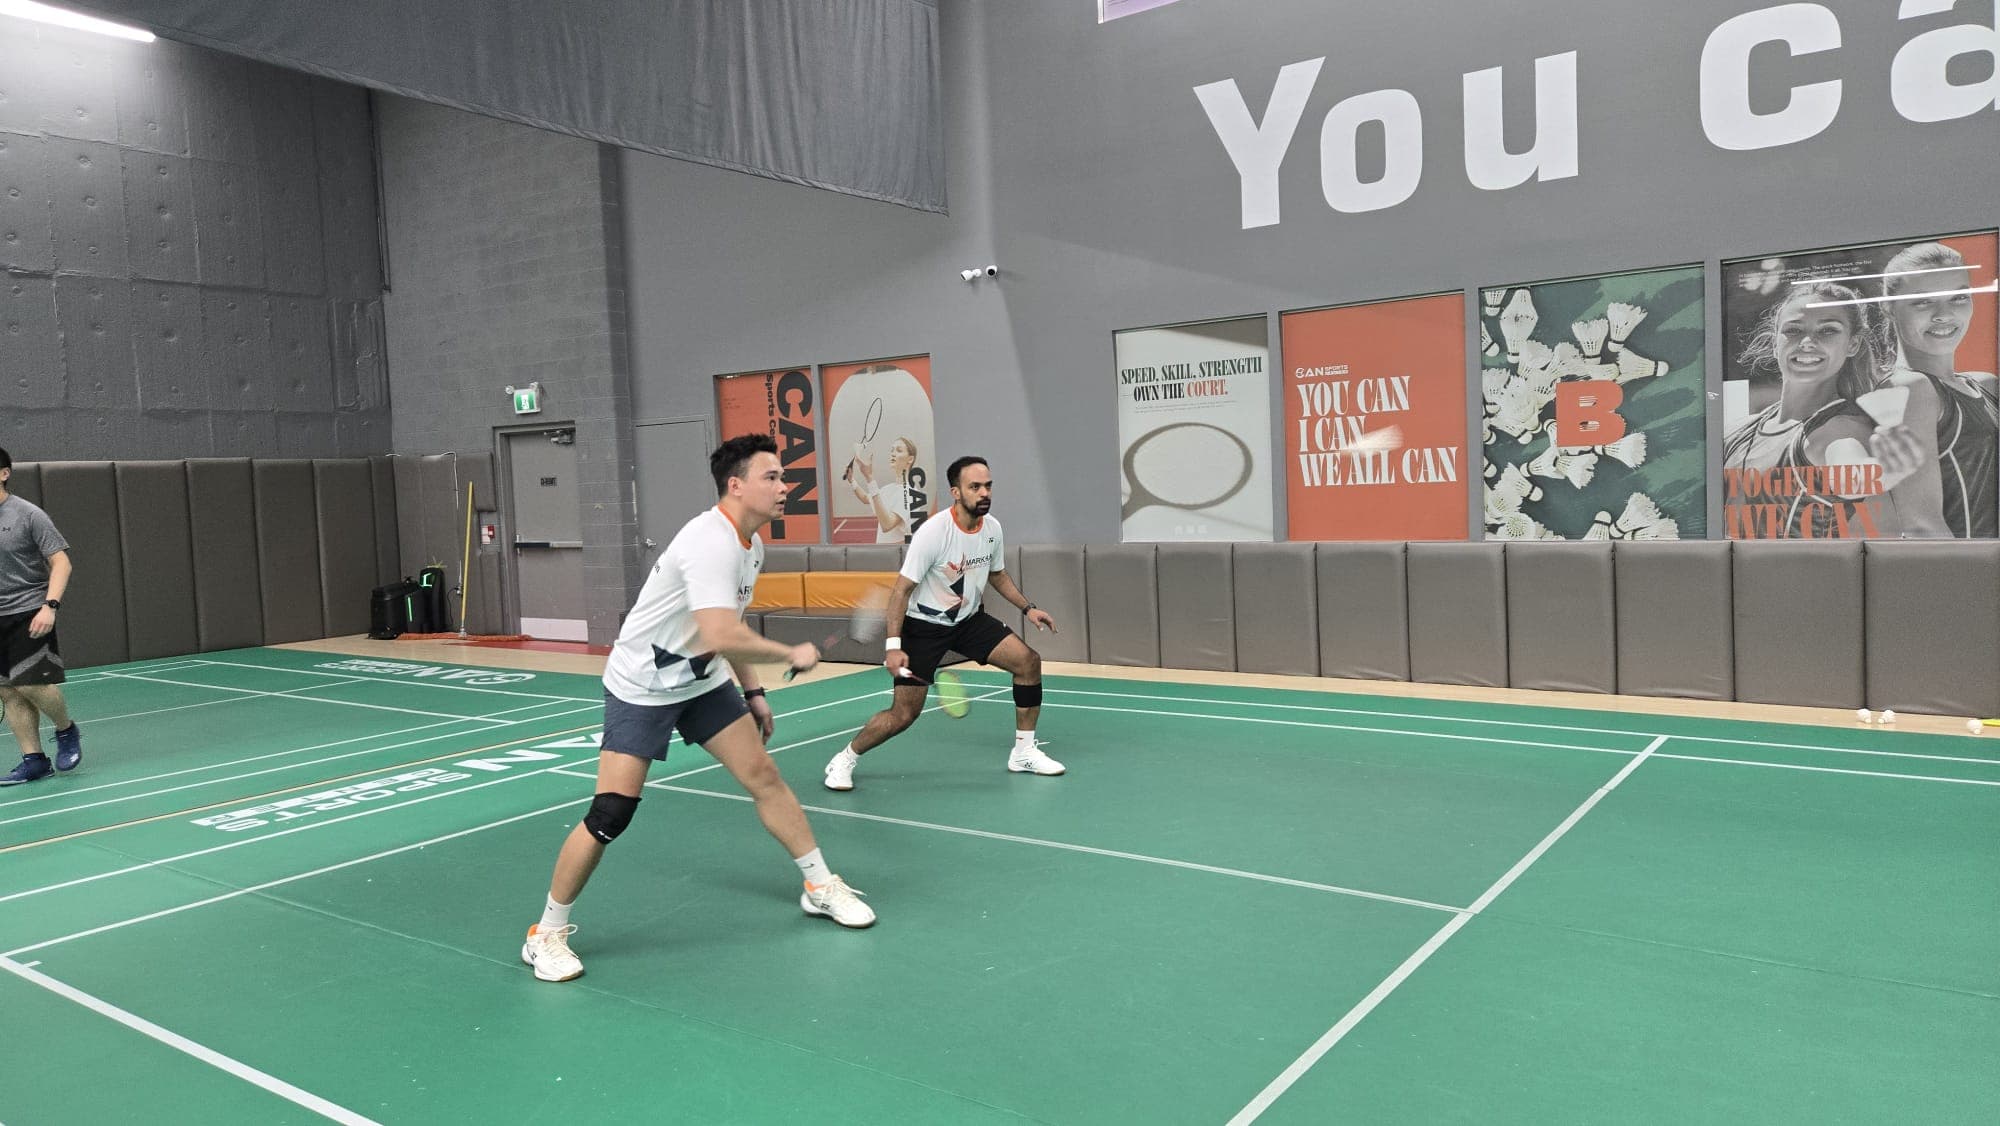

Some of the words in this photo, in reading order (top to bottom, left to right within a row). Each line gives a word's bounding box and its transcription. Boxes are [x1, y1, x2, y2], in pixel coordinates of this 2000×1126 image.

[1193, 50, 1579, 230] You
[1121, 366, 1159, 385] SPEED.
[1161, 363, 1197, 381] SKILL.
[1199, 356, 1262, 378] STRENGTH
[1133, 384, 1160, 402] OWN
[1161, 382, 1185, 400] THE
[1187, 379, 1229, 398] COURT.
[1295, 366, 1324, 378] CAN
[765, 373, 775, 417] Sports
[1297, 380, 1350, 417] YOU
[1357, 375, 1411, 413] CAN
[1555, 379, 1626, 448] B
[1299, 418, 1309, 452] I
[1314, 415, 1367, 452] CAN
[1299, 452, 1342, 487] WE
[1346, 450, 1396, 486] ALL
[1402, 446, 1459, 484] CAN
[1724, 463, 1885, 497] TOGETHER
[1724, 503, 1788, 540] WE
[452, 732, 604, 772] AN
[214, 772, 473, 833] SPORTS
